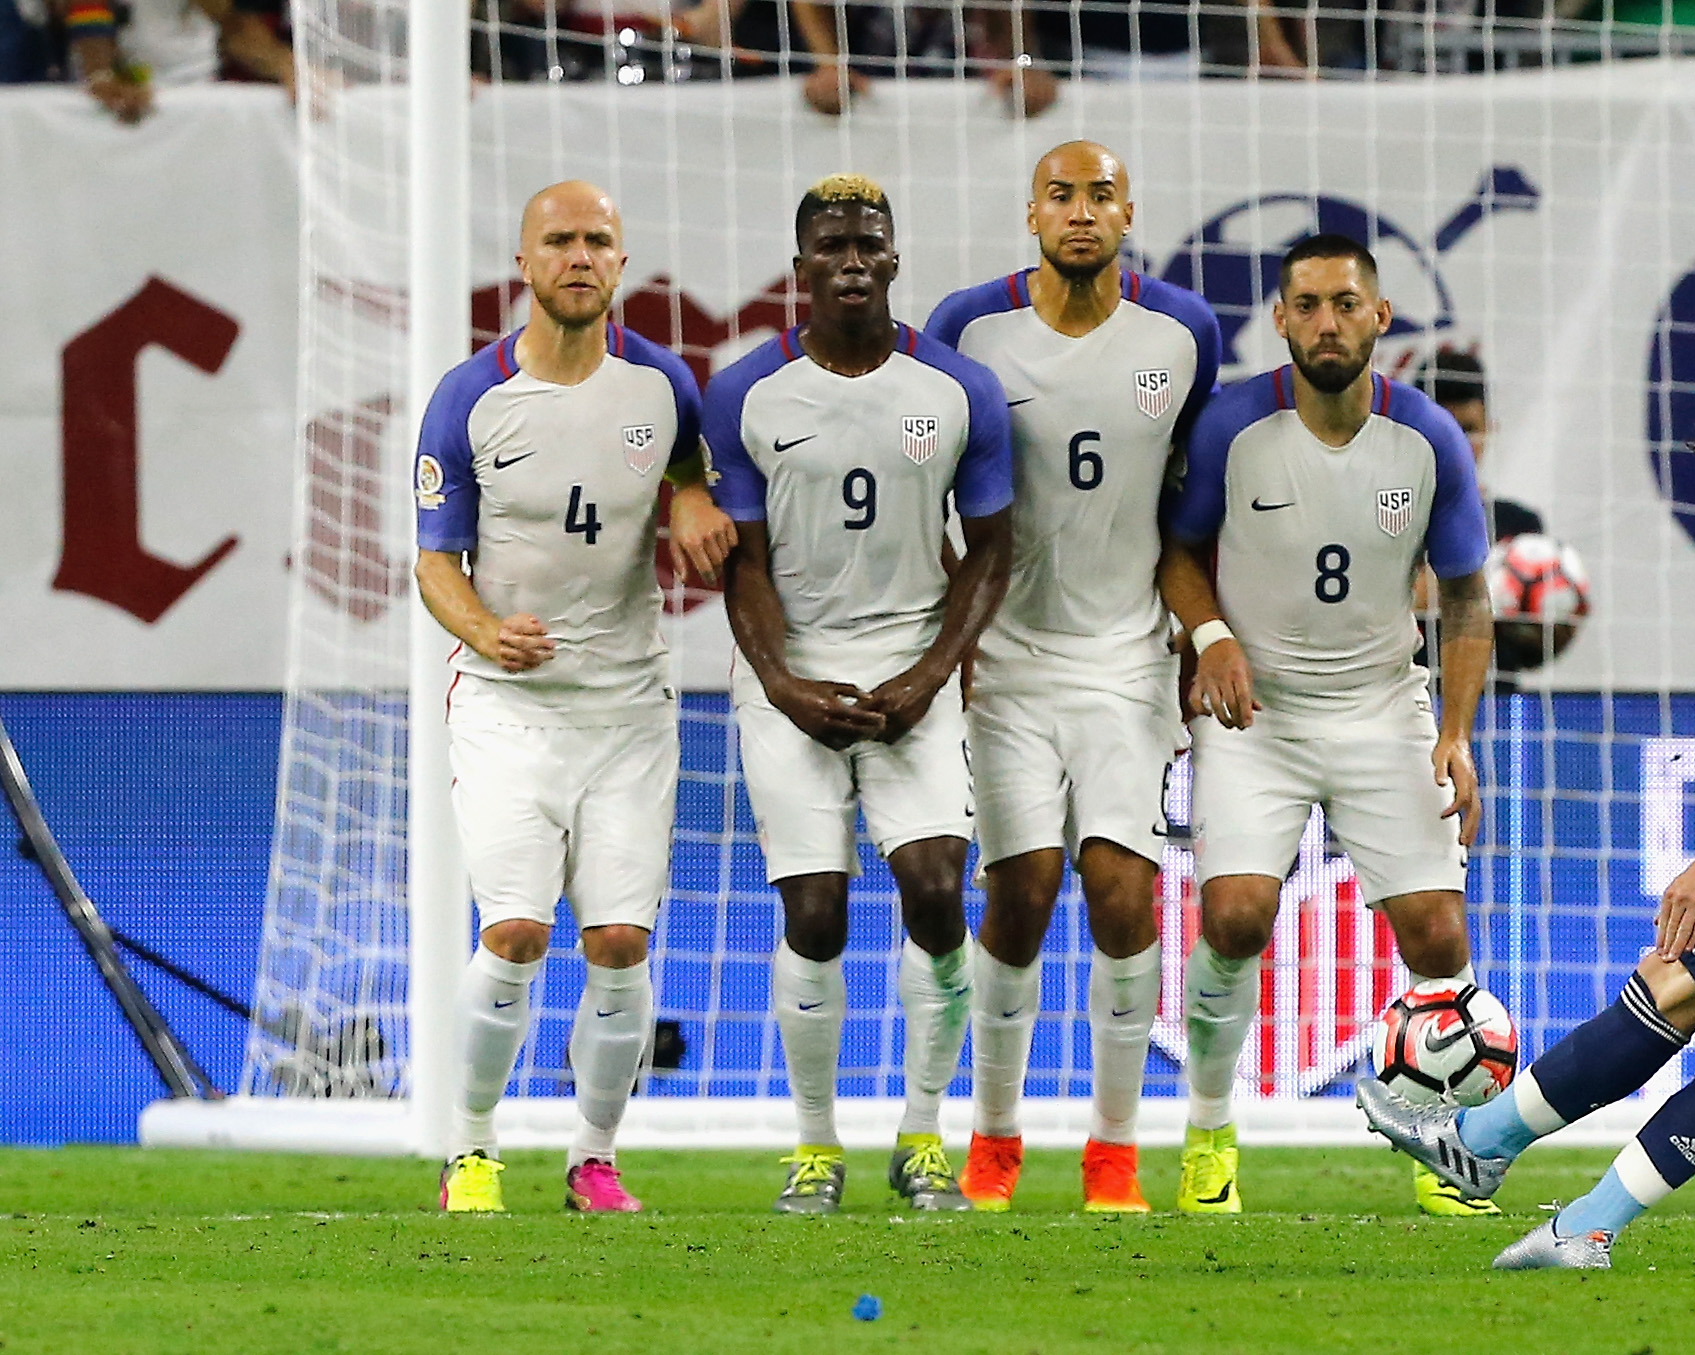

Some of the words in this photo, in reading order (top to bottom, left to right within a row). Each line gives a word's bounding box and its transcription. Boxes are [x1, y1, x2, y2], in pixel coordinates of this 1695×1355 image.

[1137, 372, 1168, 391] USA
[625, 428, 654, 447] USA
[904, 419, 936, 437] USA
[1068, 430, 1104, 491] 6
[565, 485, 602, 545] 4
[842, 467, 877, 530] 9
[1379, 491, 1410, 511] USA
[1315, 543, 1351, 604] 8
